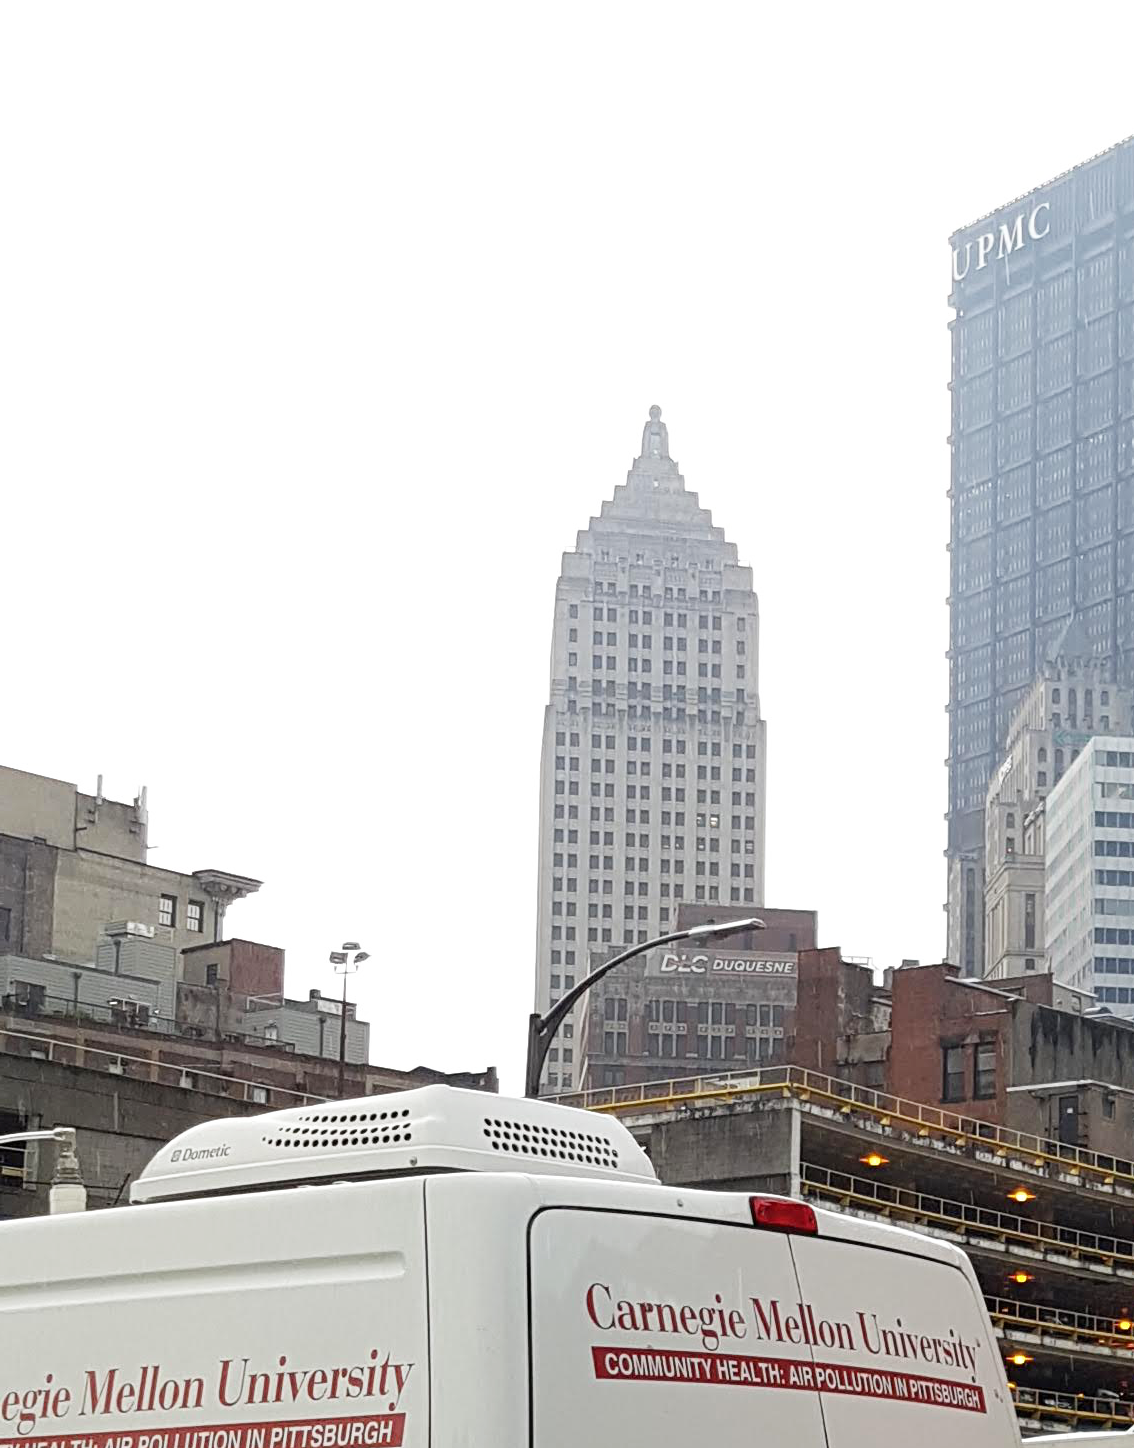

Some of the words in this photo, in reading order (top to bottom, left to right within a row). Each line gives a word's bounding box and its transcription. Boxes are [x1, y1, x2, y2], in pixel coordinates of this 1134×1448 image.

[952, 202, 1050, 281] UPMC
[712, 959, 794, 974] DUQUESNE
[182, 1144, 231, 1162] Dometic
[586, 1282, 747, 1352] Carnegie
[749, 1297, 857, 1352] Mellon
[856, 1311, 978, 1383] University
[78, 1365, 205, 1417] Mellon
[218, 1349, 415, 1412] University
[604, 1353, 713, 1380] COMMUNITY
[716, 1359, 786, 1385] HEALTH:
[789, 1365, 814, 1387] AIR
[815, 1368, 892, 1396] POLLUTION
[893, 1376, 909, 1397] IN
[909, 1379, 981, 1409] PITTSBURGH
